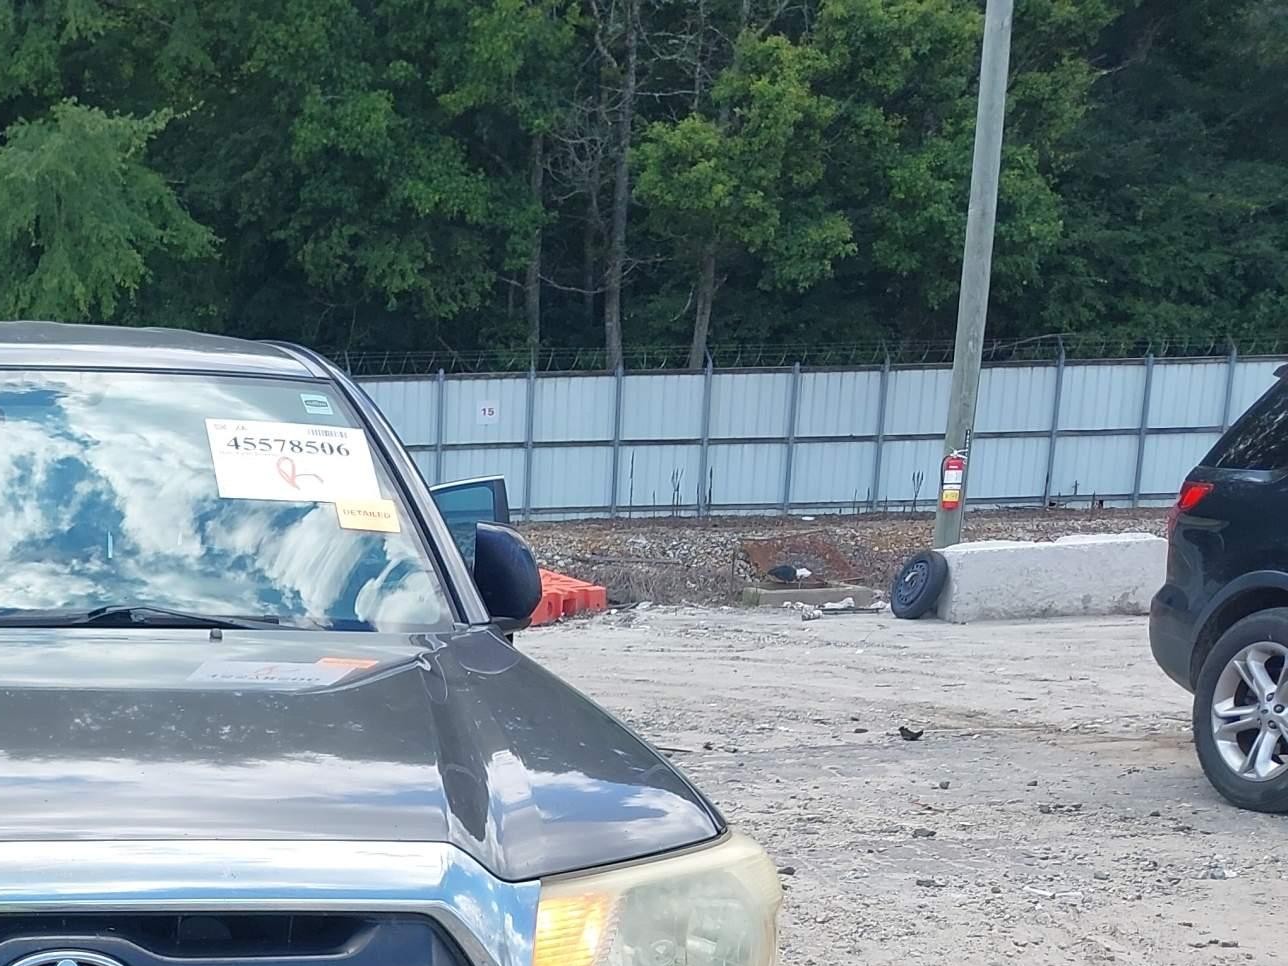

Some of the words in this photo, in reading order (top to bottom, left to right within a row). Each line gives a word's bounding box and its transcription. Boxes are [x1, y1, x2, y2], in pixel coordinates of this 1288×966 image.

[481, 407, 495, 416] 15
[227, 437, 350, 457] 45578506
[343, 508, 392, 520] DETAILED
